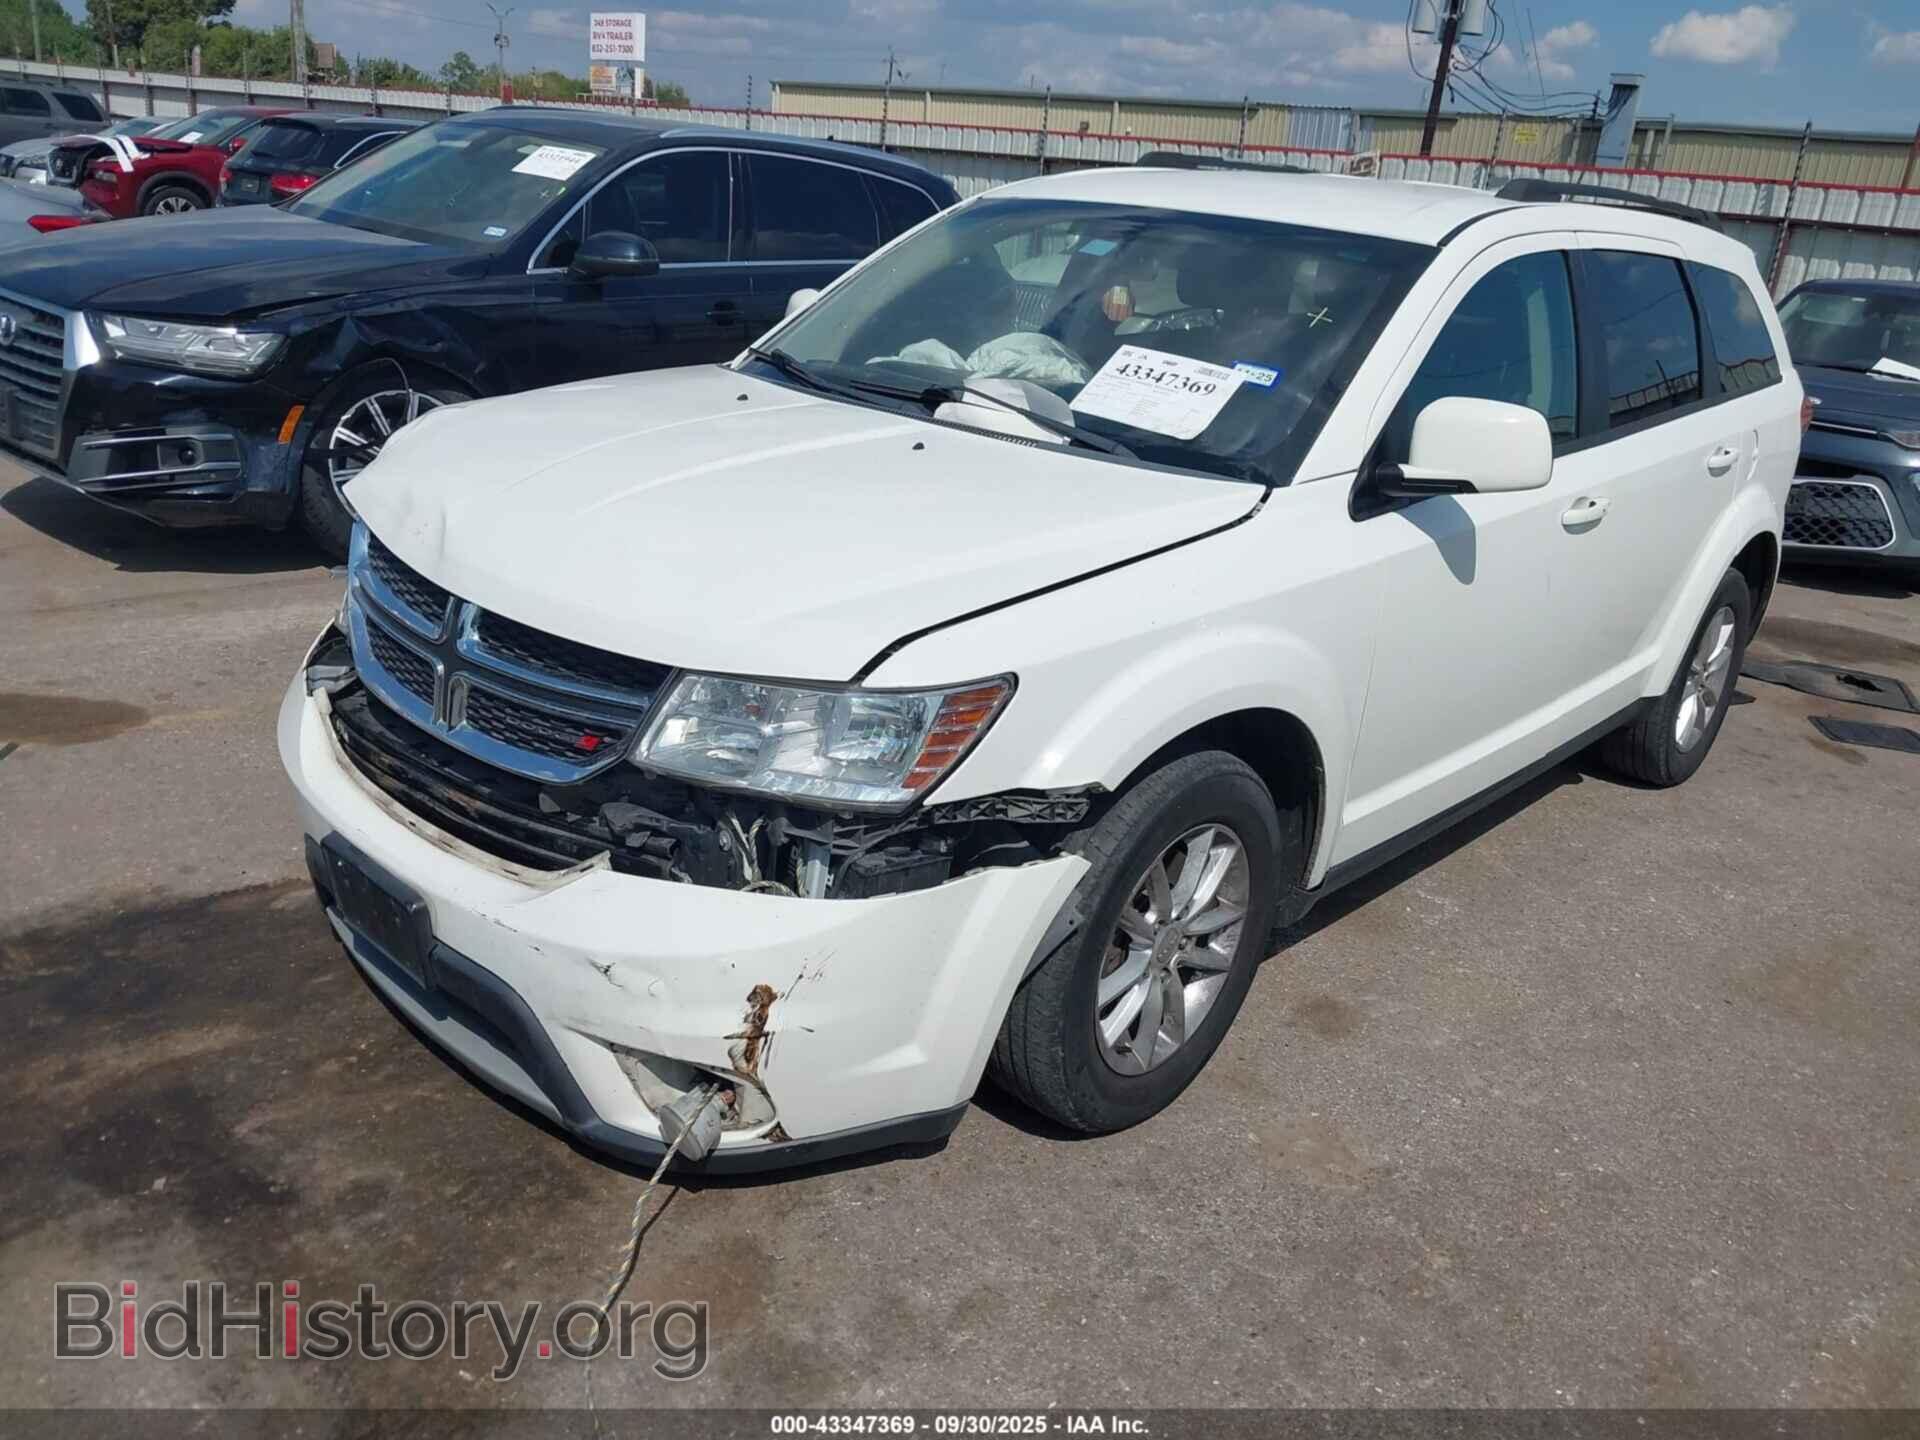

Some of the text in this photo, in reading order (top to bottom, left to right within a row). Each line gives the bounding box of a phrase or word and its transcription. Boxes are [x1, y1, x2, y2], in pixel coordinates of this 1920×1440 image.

[605, 19, 632, 28] STORAGE
[607, 31, 633, 41] TRAILER
[1115, 362, 1217, 396] 43347369
